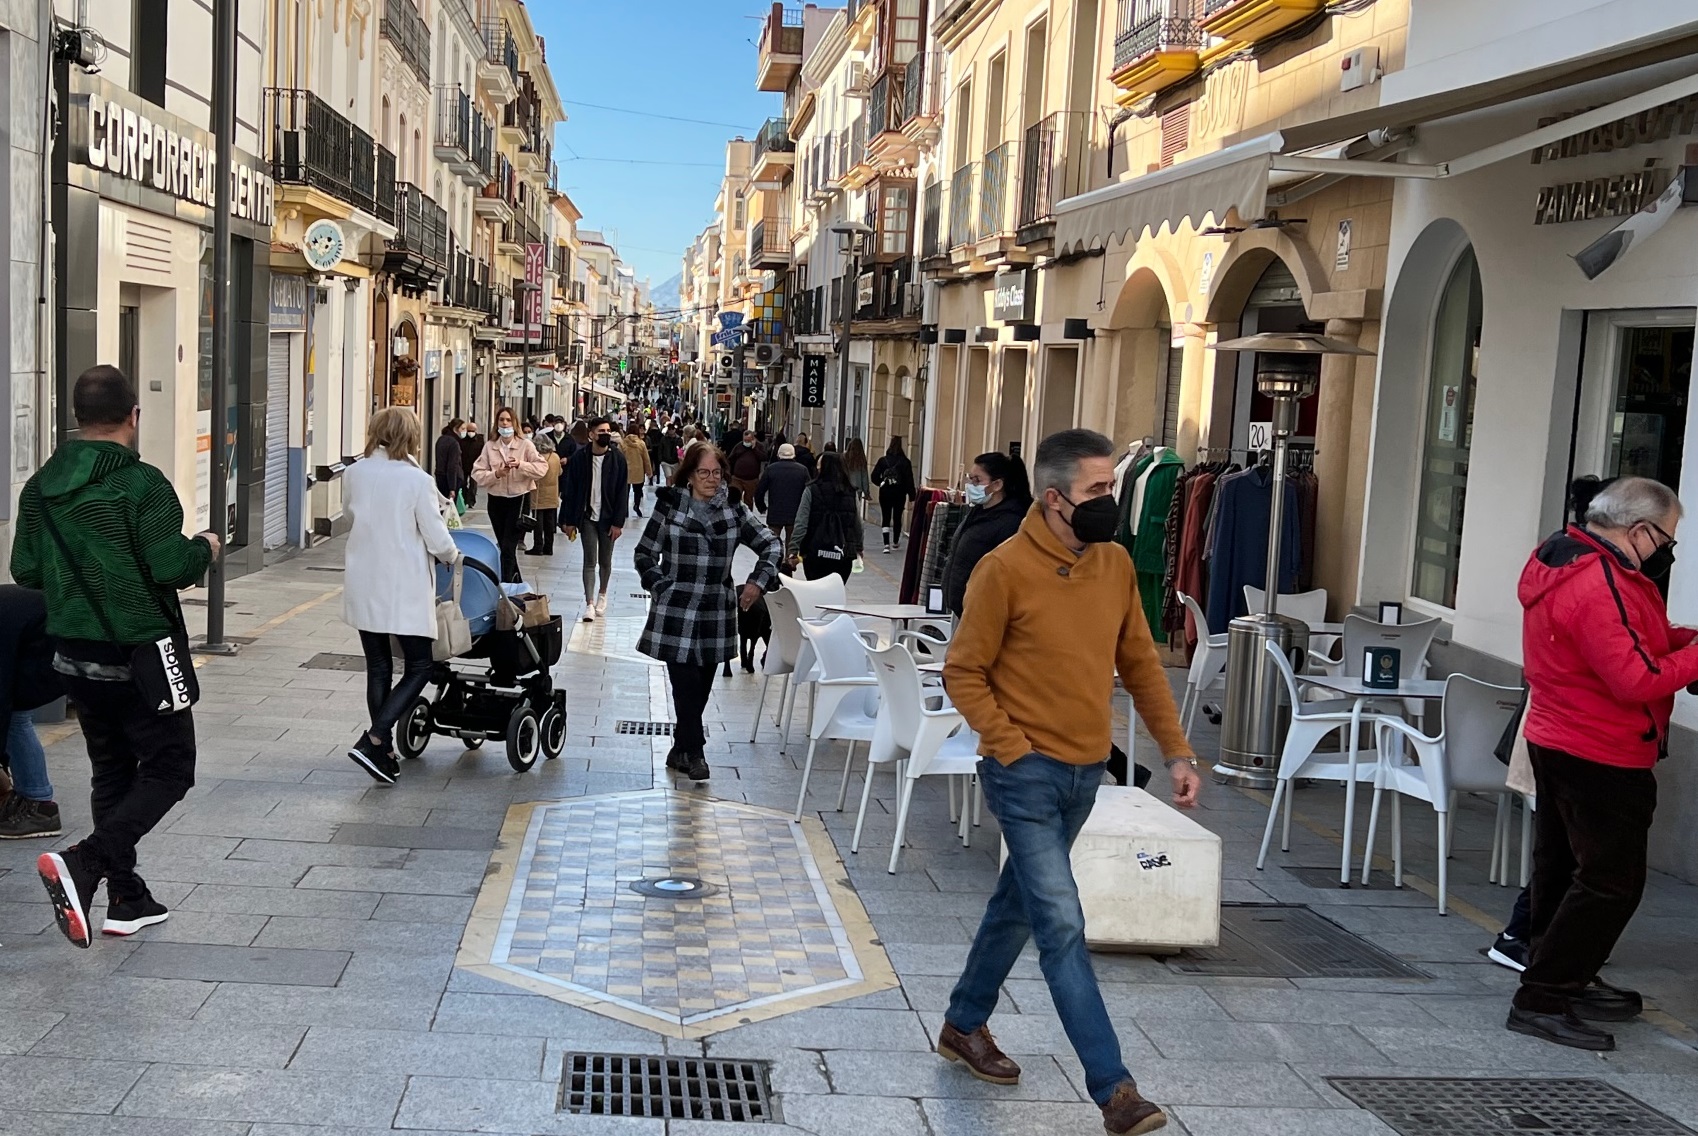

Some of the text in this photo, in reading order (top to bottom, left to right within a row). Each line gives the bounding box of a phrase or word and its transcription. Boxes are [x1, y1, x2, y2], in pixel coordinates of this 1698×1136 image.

[89, 93, 217, 208] CORPORACIO
[808, 359, 819, 403] MANGO
[817, 549, 841, 560] PUMA
[164, 642, 190, 703] adidas
